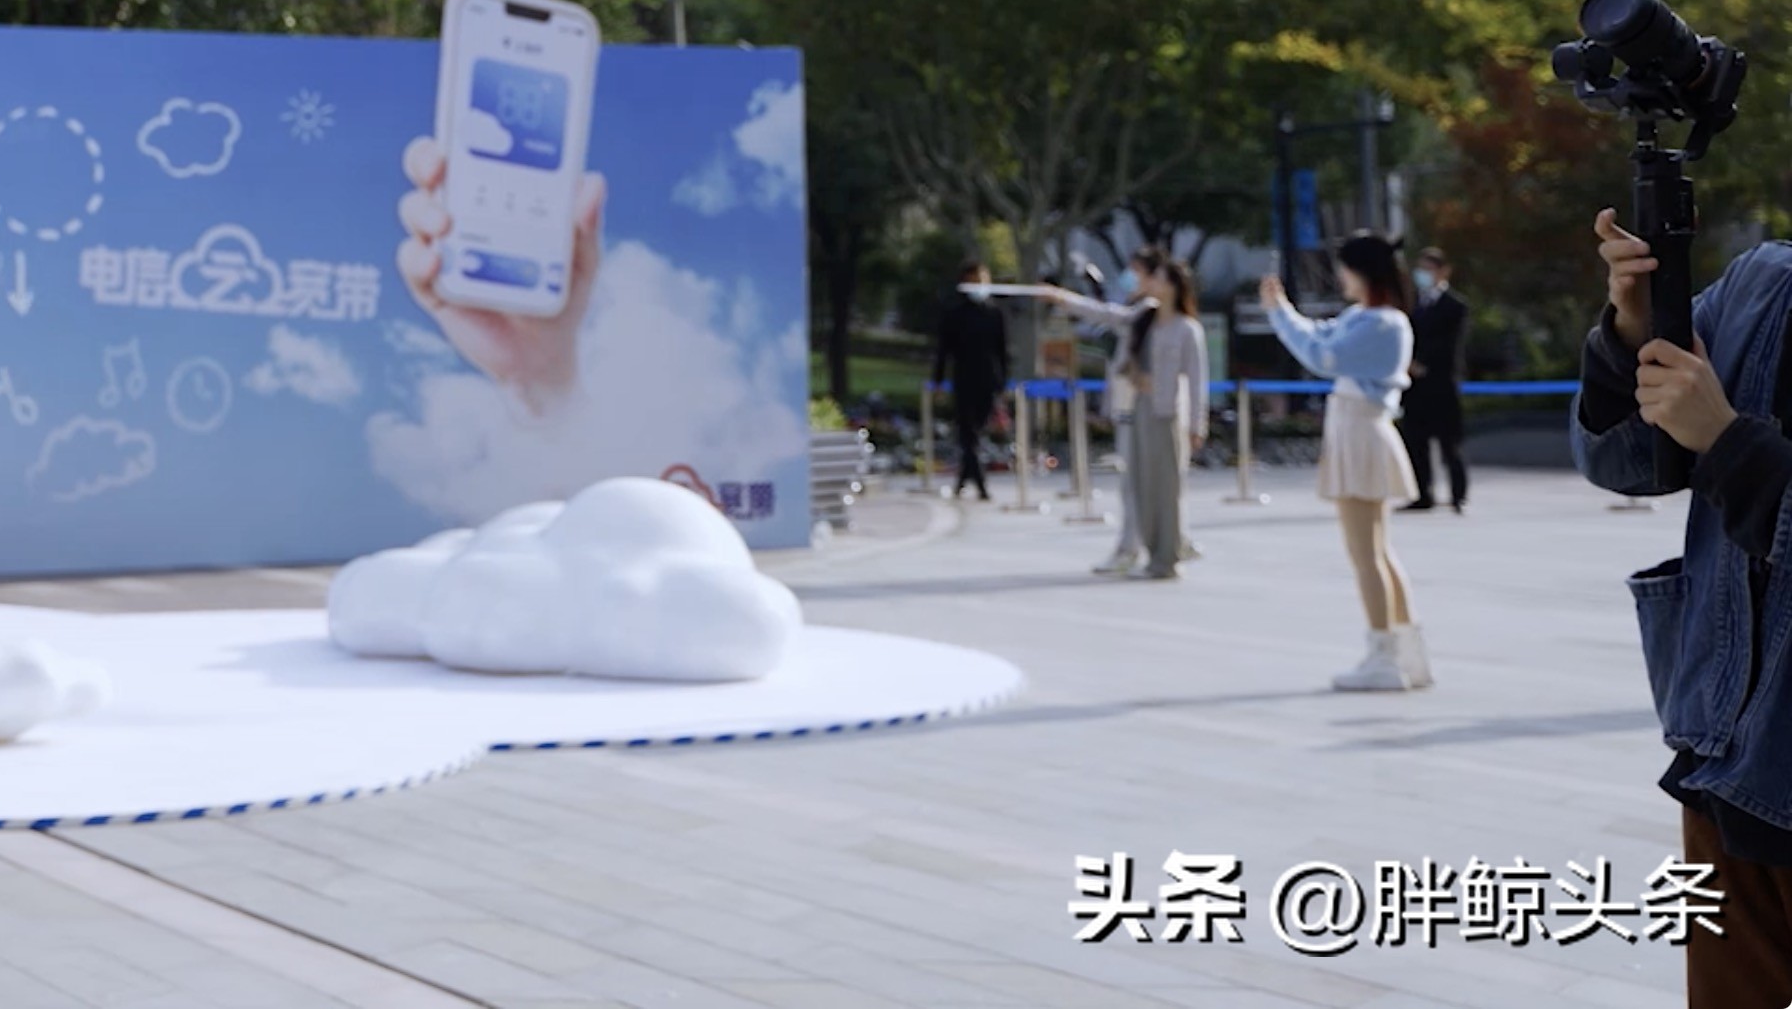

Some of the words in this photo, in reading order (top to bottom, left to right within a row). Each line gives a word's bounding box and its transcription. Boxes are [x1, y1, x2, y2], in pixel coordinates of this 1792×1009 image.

[80, 244, 382, 320] 电信云宽带
